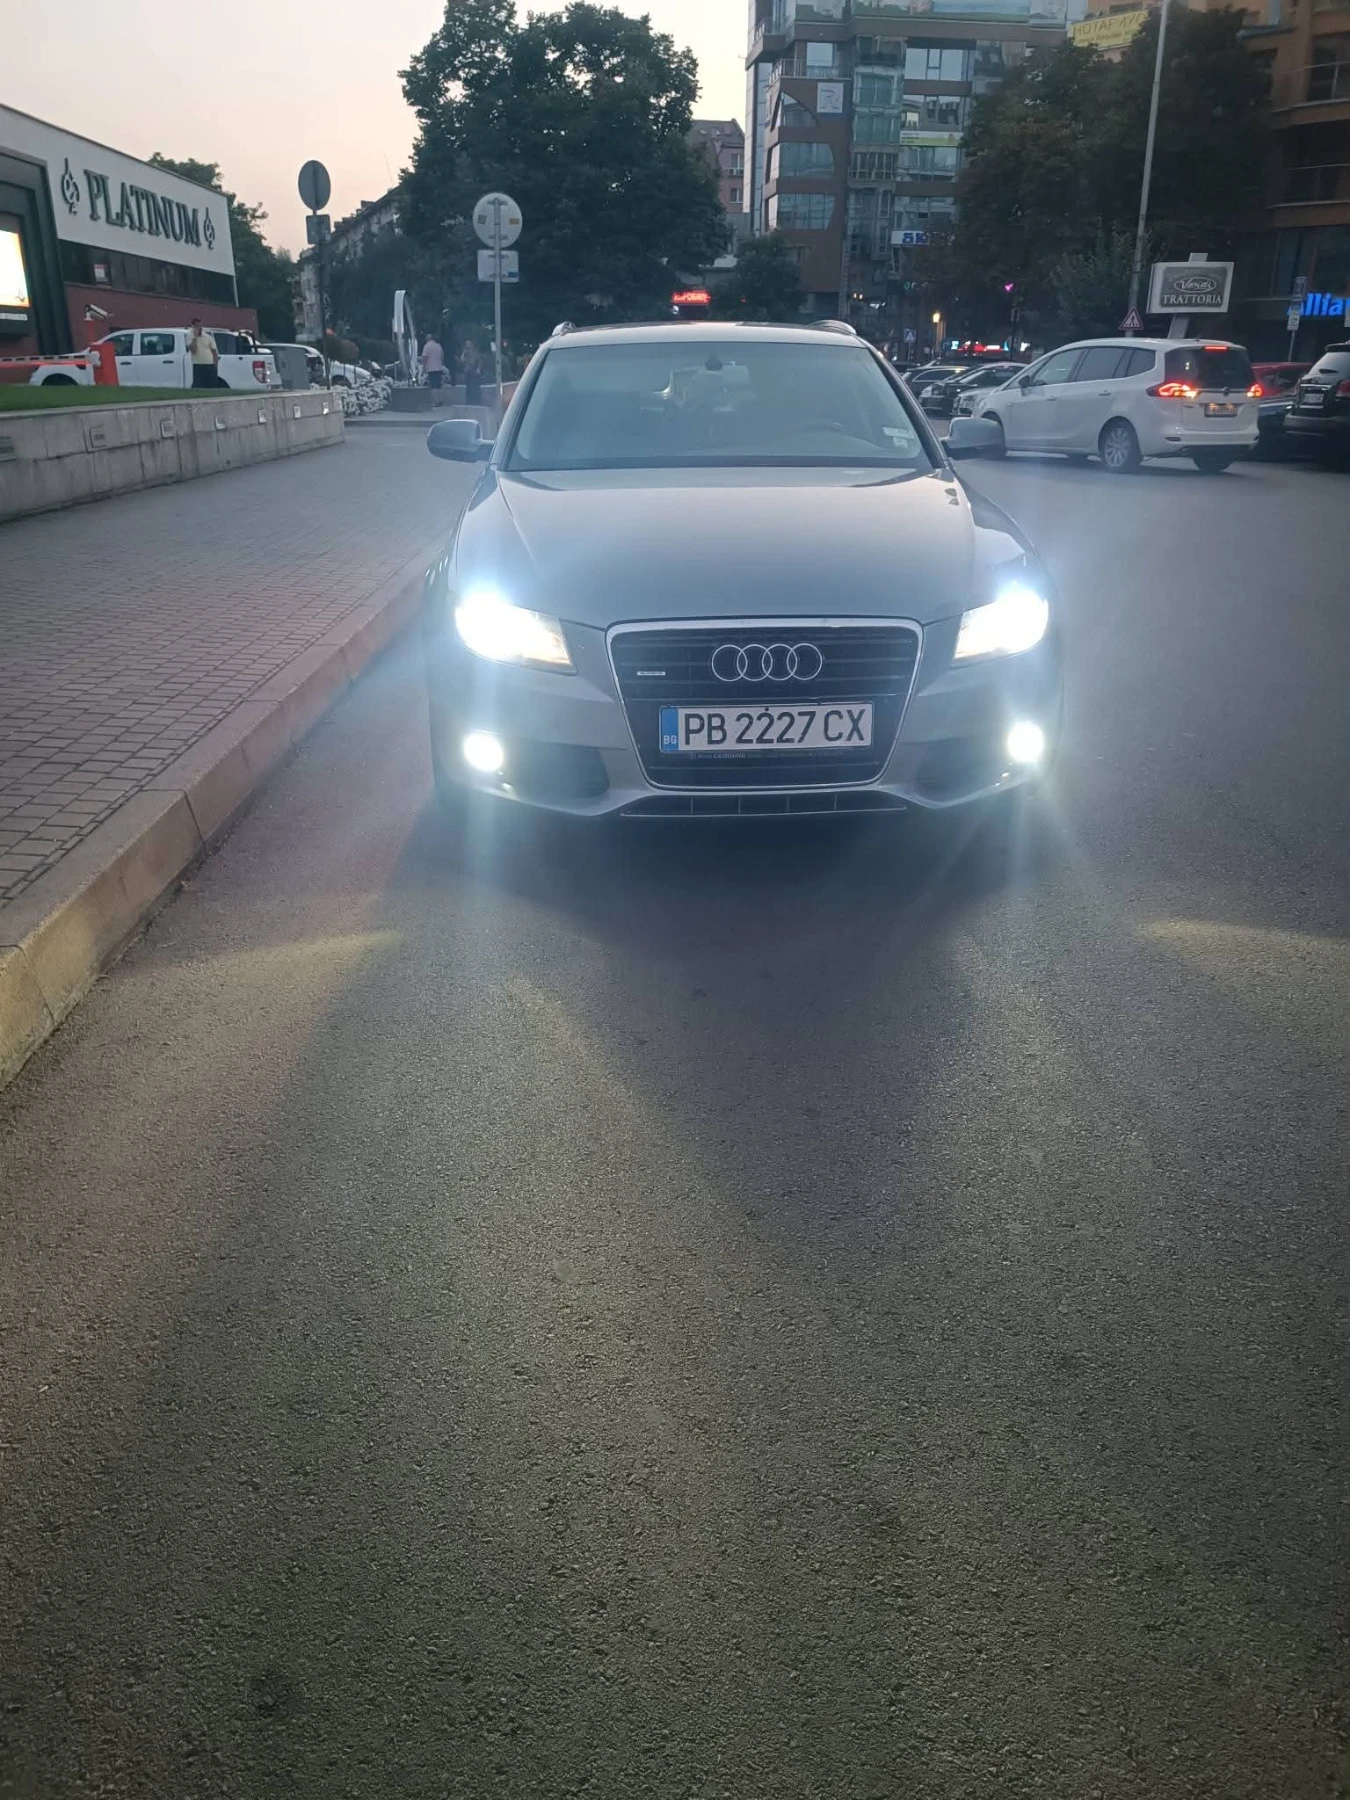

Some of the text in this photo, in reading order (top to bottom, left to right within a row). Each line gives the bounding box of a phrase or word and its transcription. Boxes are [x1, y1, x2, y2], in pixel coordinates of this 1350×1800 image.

[83, 169, 202, 247] PLATINUM
[1162, 294, 1221, 304] TRATTORIA
[1287, 292, 1350, 316] Allia
[684, 709, 866, 745] PB 2227 CX
[663, 735, 677, 744] BG
